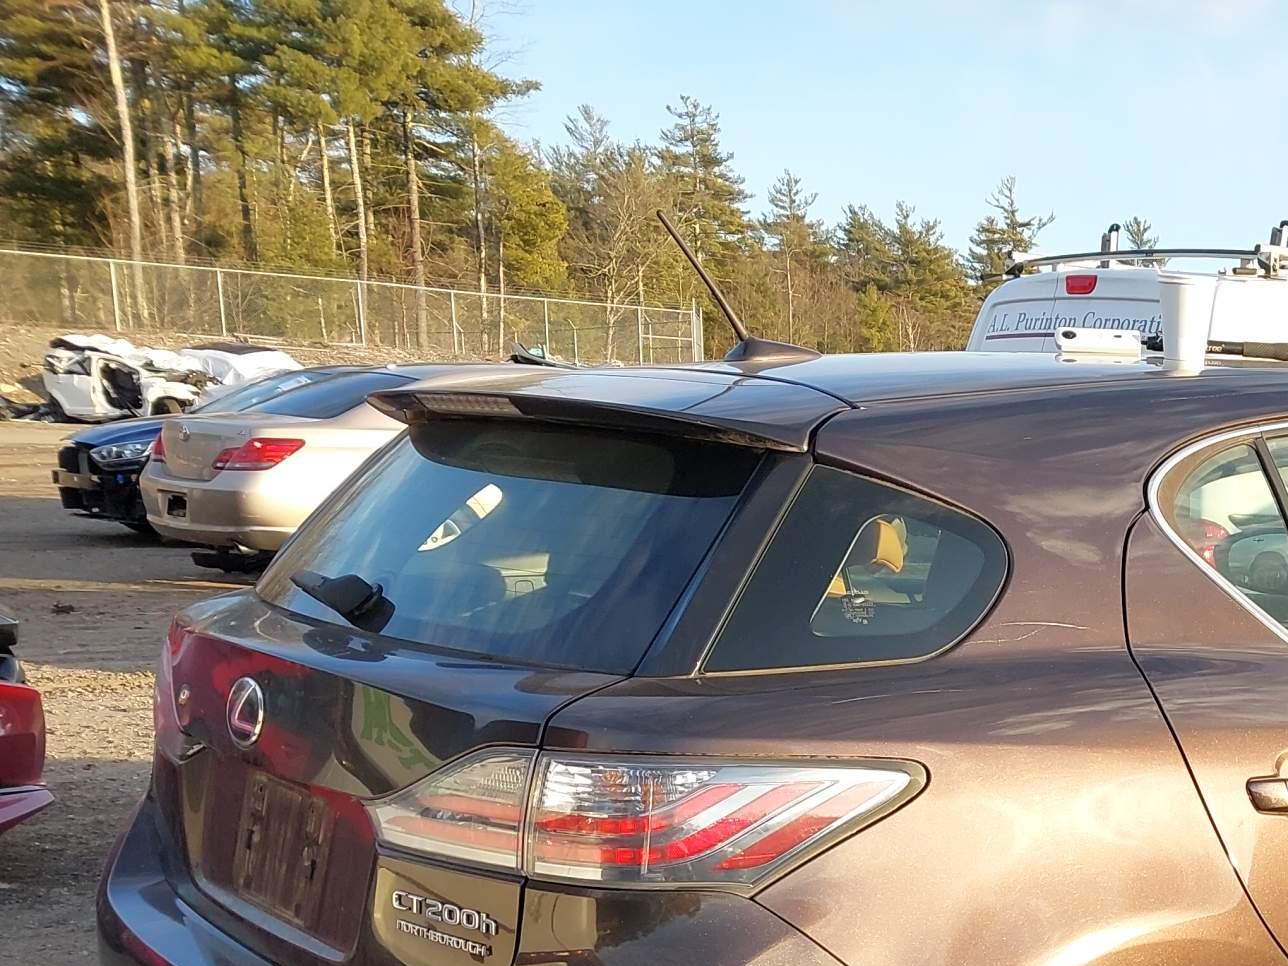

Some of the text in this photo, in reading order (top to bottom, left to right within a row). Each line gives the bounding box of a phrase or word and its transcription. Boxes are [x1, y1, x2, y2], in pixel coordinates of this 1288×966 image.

[988, 310, 1163, 334] A.L. Purinton Corporati
[396, 918, 490, 957] NORTHBOROUGH
